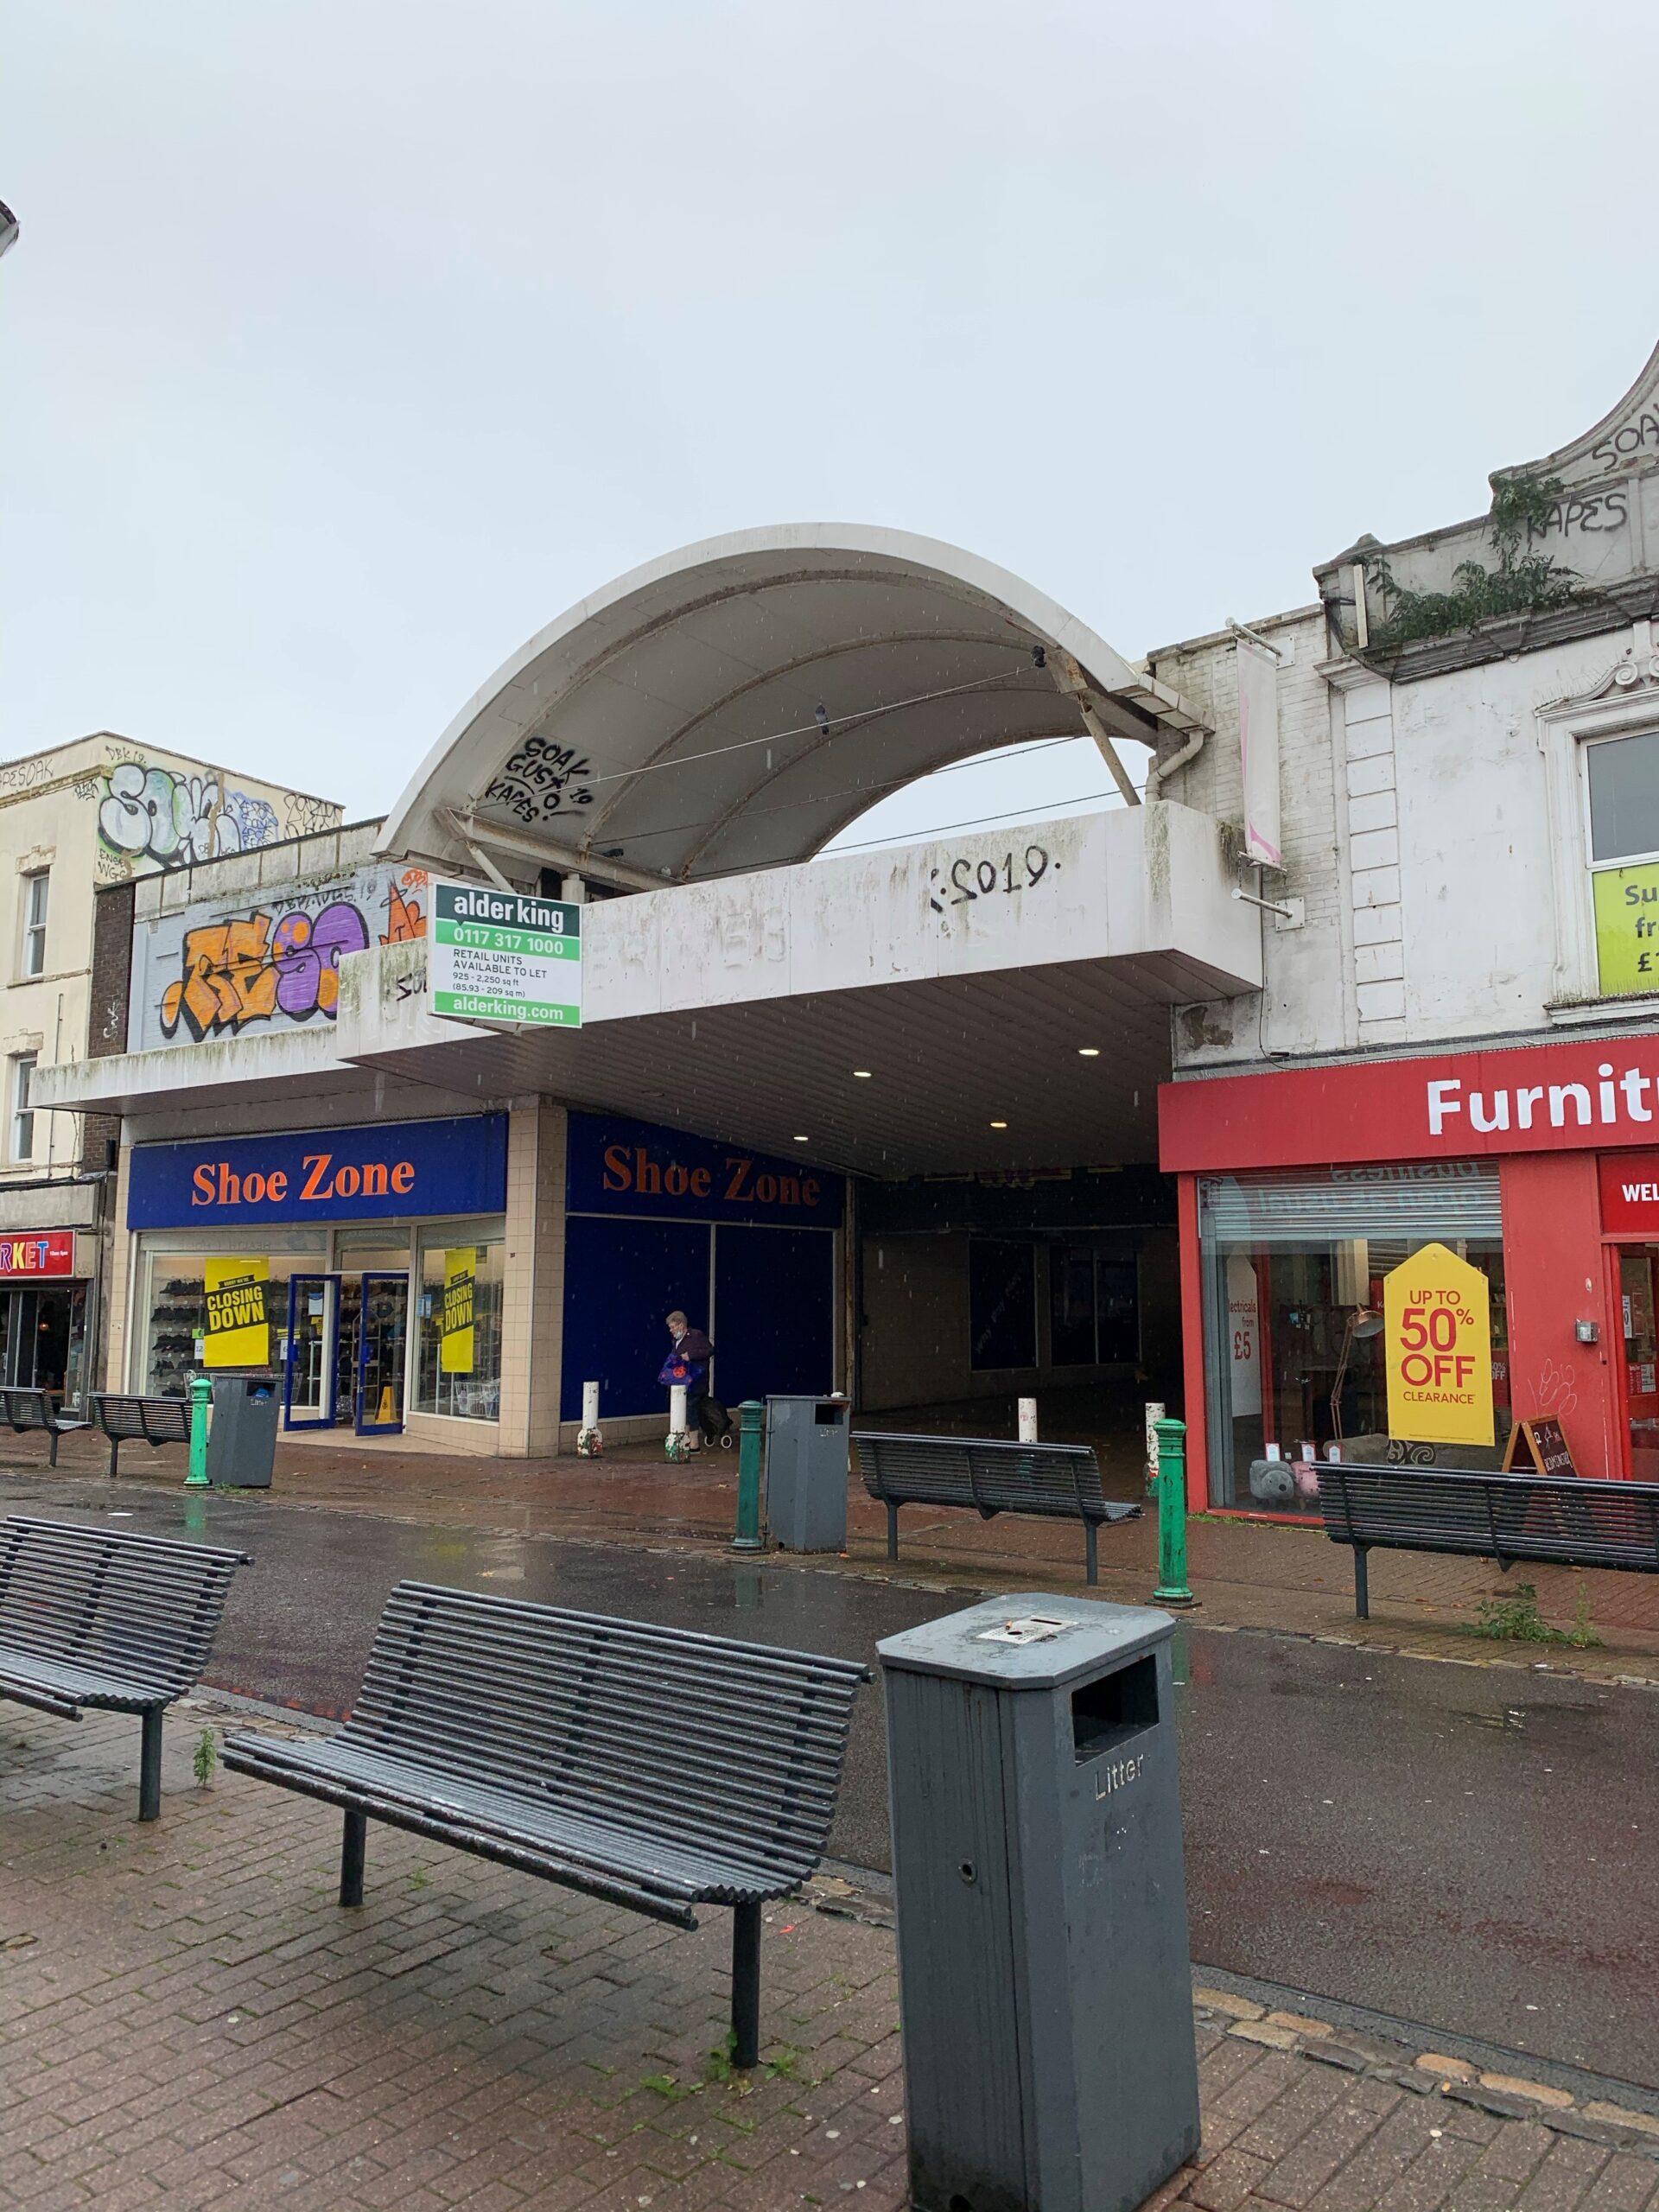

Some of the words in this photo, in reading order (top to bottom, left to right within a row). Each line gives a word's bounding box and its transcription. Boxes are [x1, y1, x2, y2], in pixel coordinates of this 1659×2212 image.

[1592, 403, 1659, 471] SOA
[524, 737, 590, 785] SOAK
[454, 892, 513, 922] alder
[518, 899, 563, 934] king
[454, 927, 490, 945] 0117
[494, 932, 521, 950] 317
[527, 938, 563, 955] 1000
[1635, 917, 1659, 938] fr
[454, 949, 490, 962] RETAIL
[493, 953, 523, 965] UNITS
[454, 960, 511, 975] AVAILABLE
[514, 967, 527, 976] TO
[530, 969, 547, 979] LET
[453, 972, 469, 981] 925
[502, 978, 511, 987] sq
[486, 987, 503, 995] 209
[454, 996, 563, 1020] alderking.com
[1427, 1063, 1659, 1135] Furnit
[192, 1162, 288, 1206] Shoe
[299, 1154, 416, 1200] Zone
[603, 1144, 712, 1198] Shoe
[724, 1157, 820, 1207] Zone
[207, 1286, 264, 1311] CLOSING
[444, 1282, 473, 1309] CLOSING
[1409, 1290, 1433, 1306] UP
[1435, 1290, 1461, 1306] TO
[208, 1301, 264, 1332] DOWN
[445, 1300, 473, 1332] DOWN
[1242, 1316, 1255, 1327] from
[1234, 1331, 1251, 1360] £5
[1401, 1353, 1476, 1389] OFF
[1403, 1391, 1475, 1405] CLEARANCE
[1096, 1753, 1144, 1801] Litter
